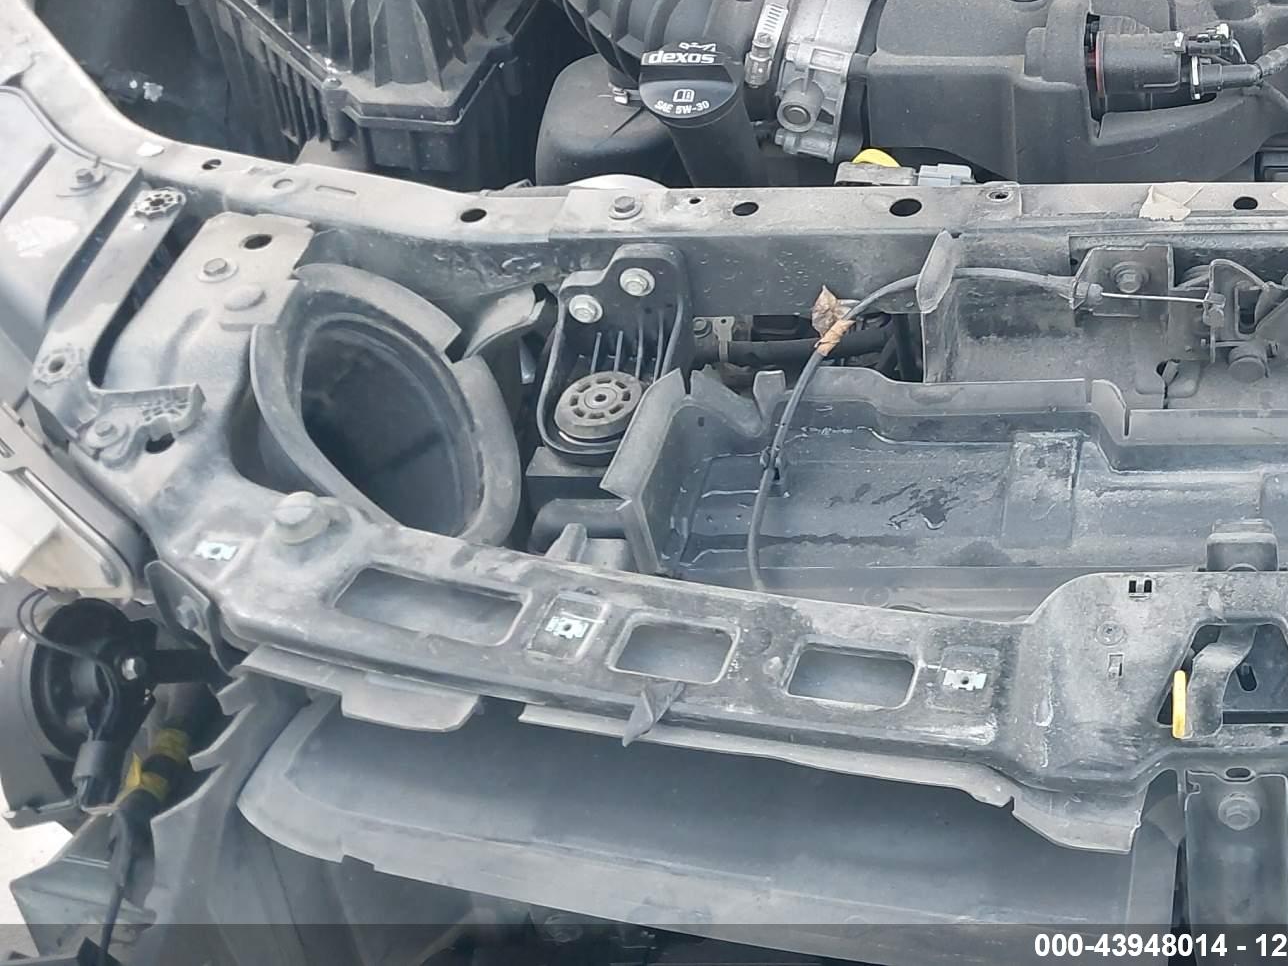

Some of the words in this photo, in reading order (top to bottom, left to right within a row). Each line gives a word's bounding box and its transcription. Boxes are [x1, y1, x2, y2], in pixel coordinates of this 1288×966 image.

[648, 50, 717, 64] dexos
[654, 100, 673, 113] SAE
[675, 100, 710, 115] 5W-30
